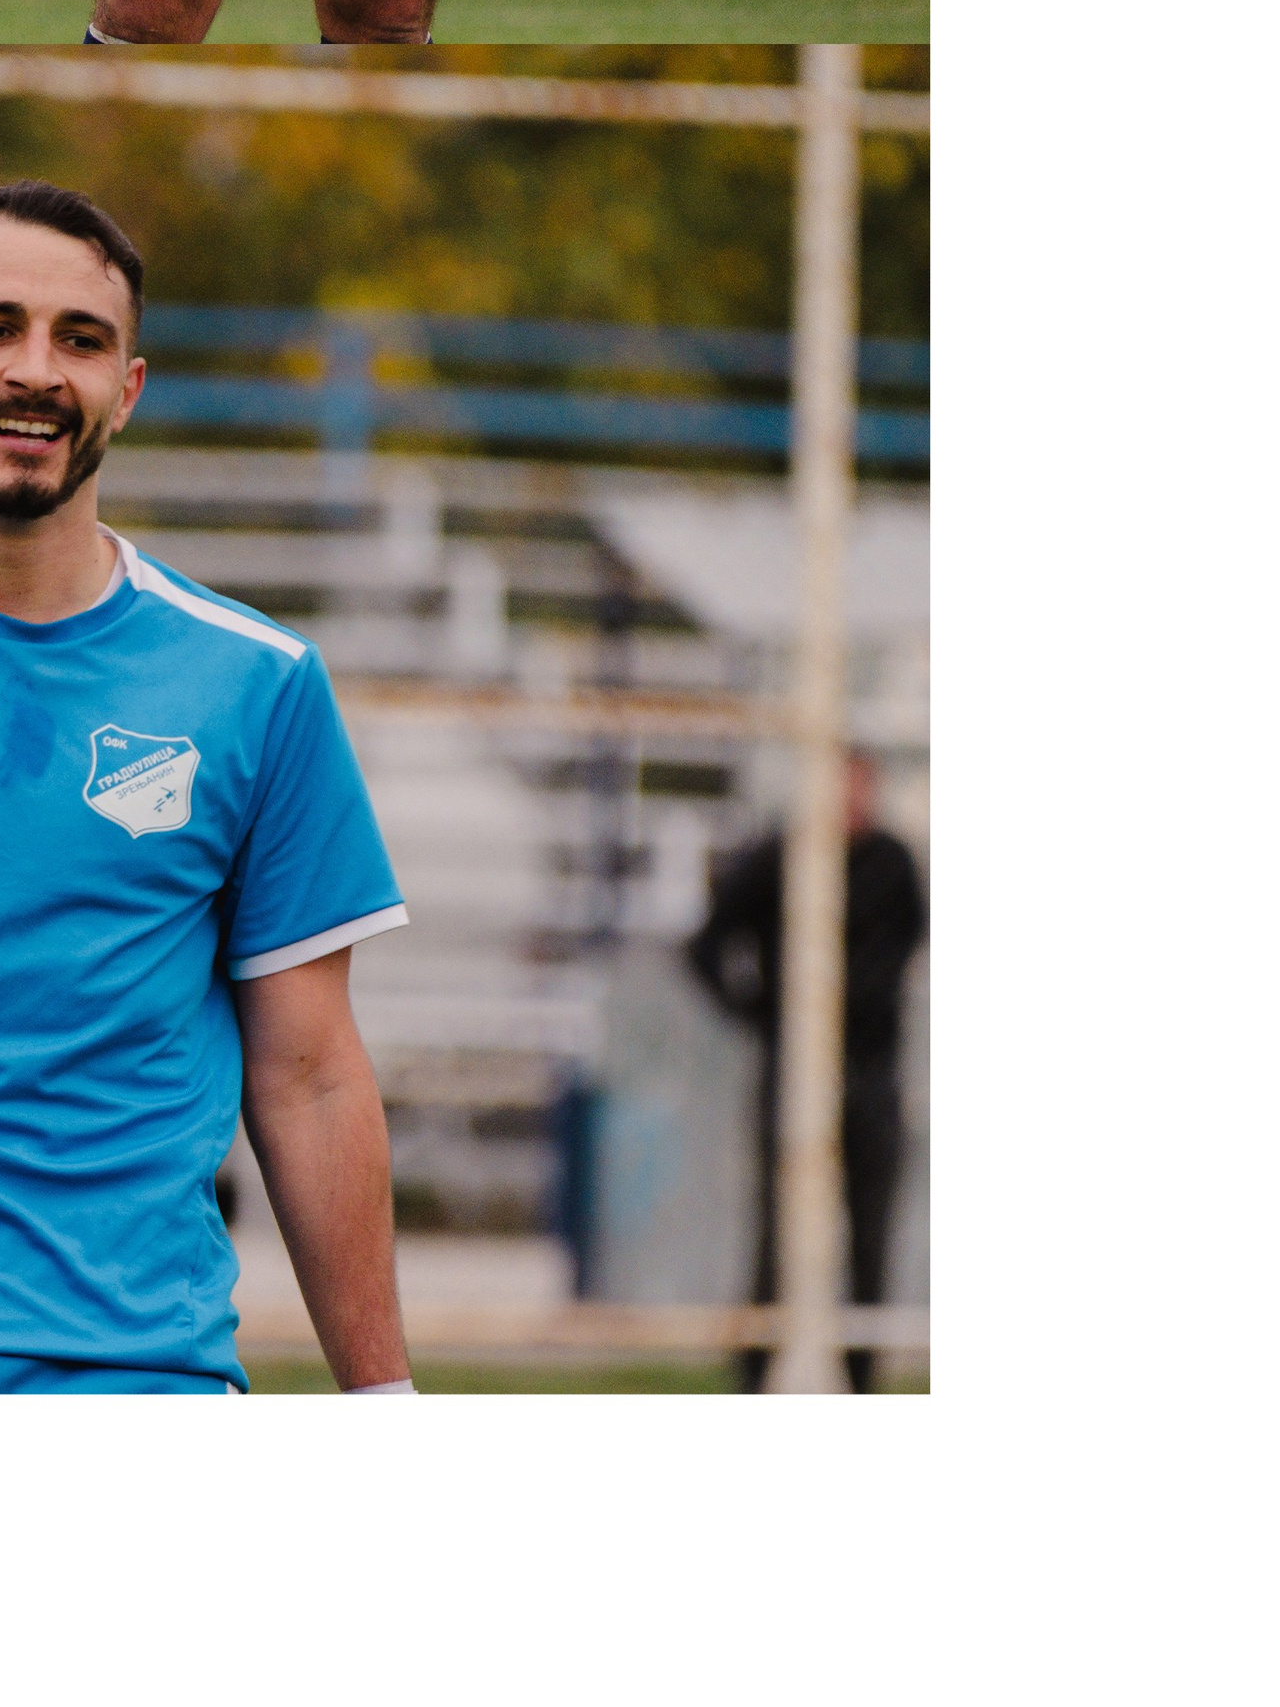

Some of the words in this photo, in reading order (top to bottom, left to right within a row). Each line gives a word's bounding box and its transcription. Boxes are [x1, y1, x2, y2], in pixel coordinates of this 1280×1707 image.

[102, 735, 128, 750] ОФК
[97, 745, 177, 791] ГРАДНУЛИЦА
[115, 765, 176, 800] ЗРЕЊАНИН
